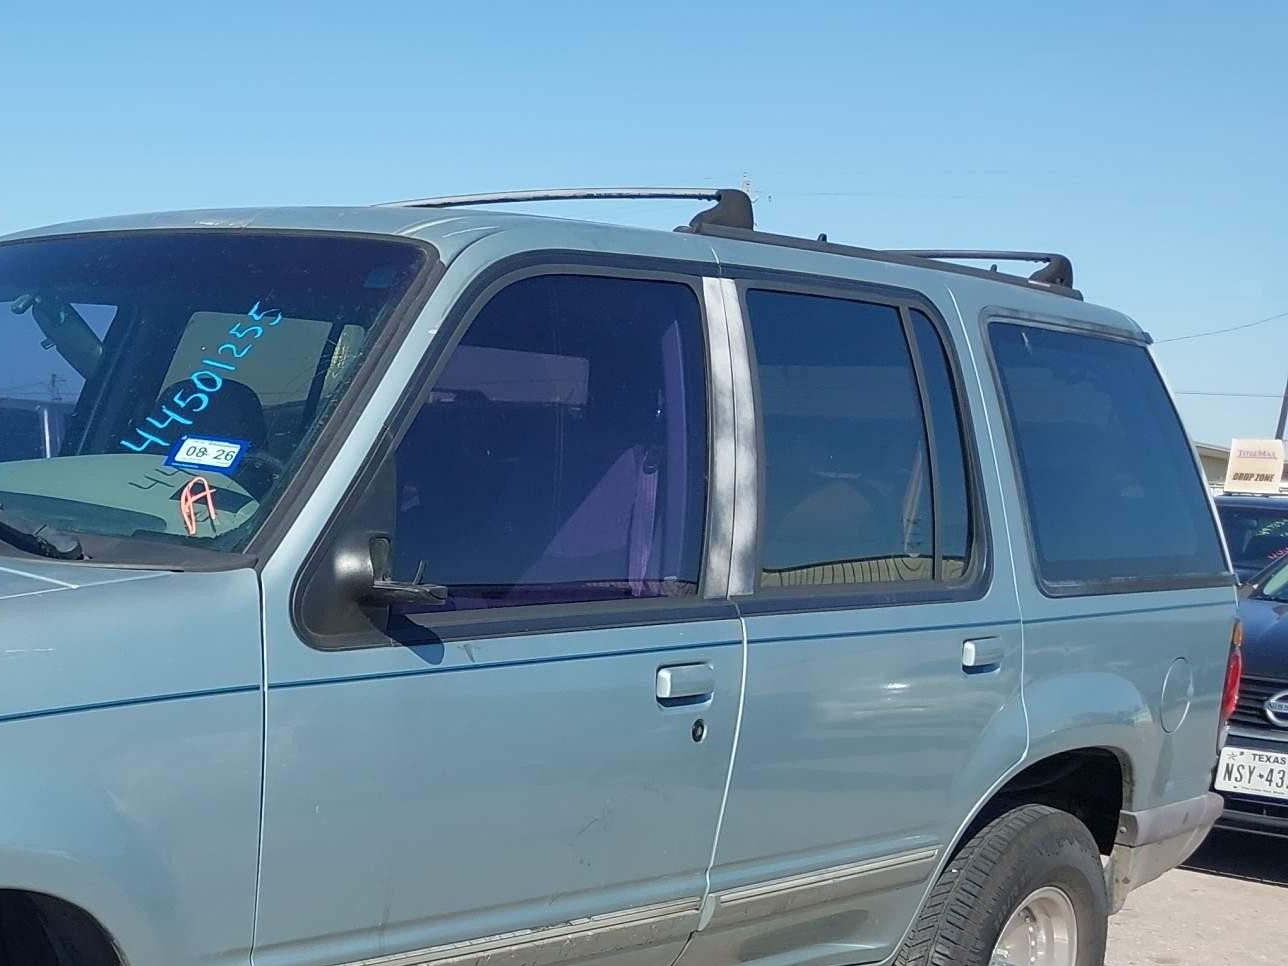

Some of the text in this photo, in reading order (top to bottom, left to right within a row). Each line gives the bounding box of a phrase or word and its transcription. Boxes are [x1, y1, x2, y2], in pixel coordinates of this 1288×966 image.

[120, 300, 282, 452] 44501255
[213, 448, 236, 462] 26
[1232, 472, 1276, 483] DROP ZONE
[1251, 753, 1287, 766] TEXAS
